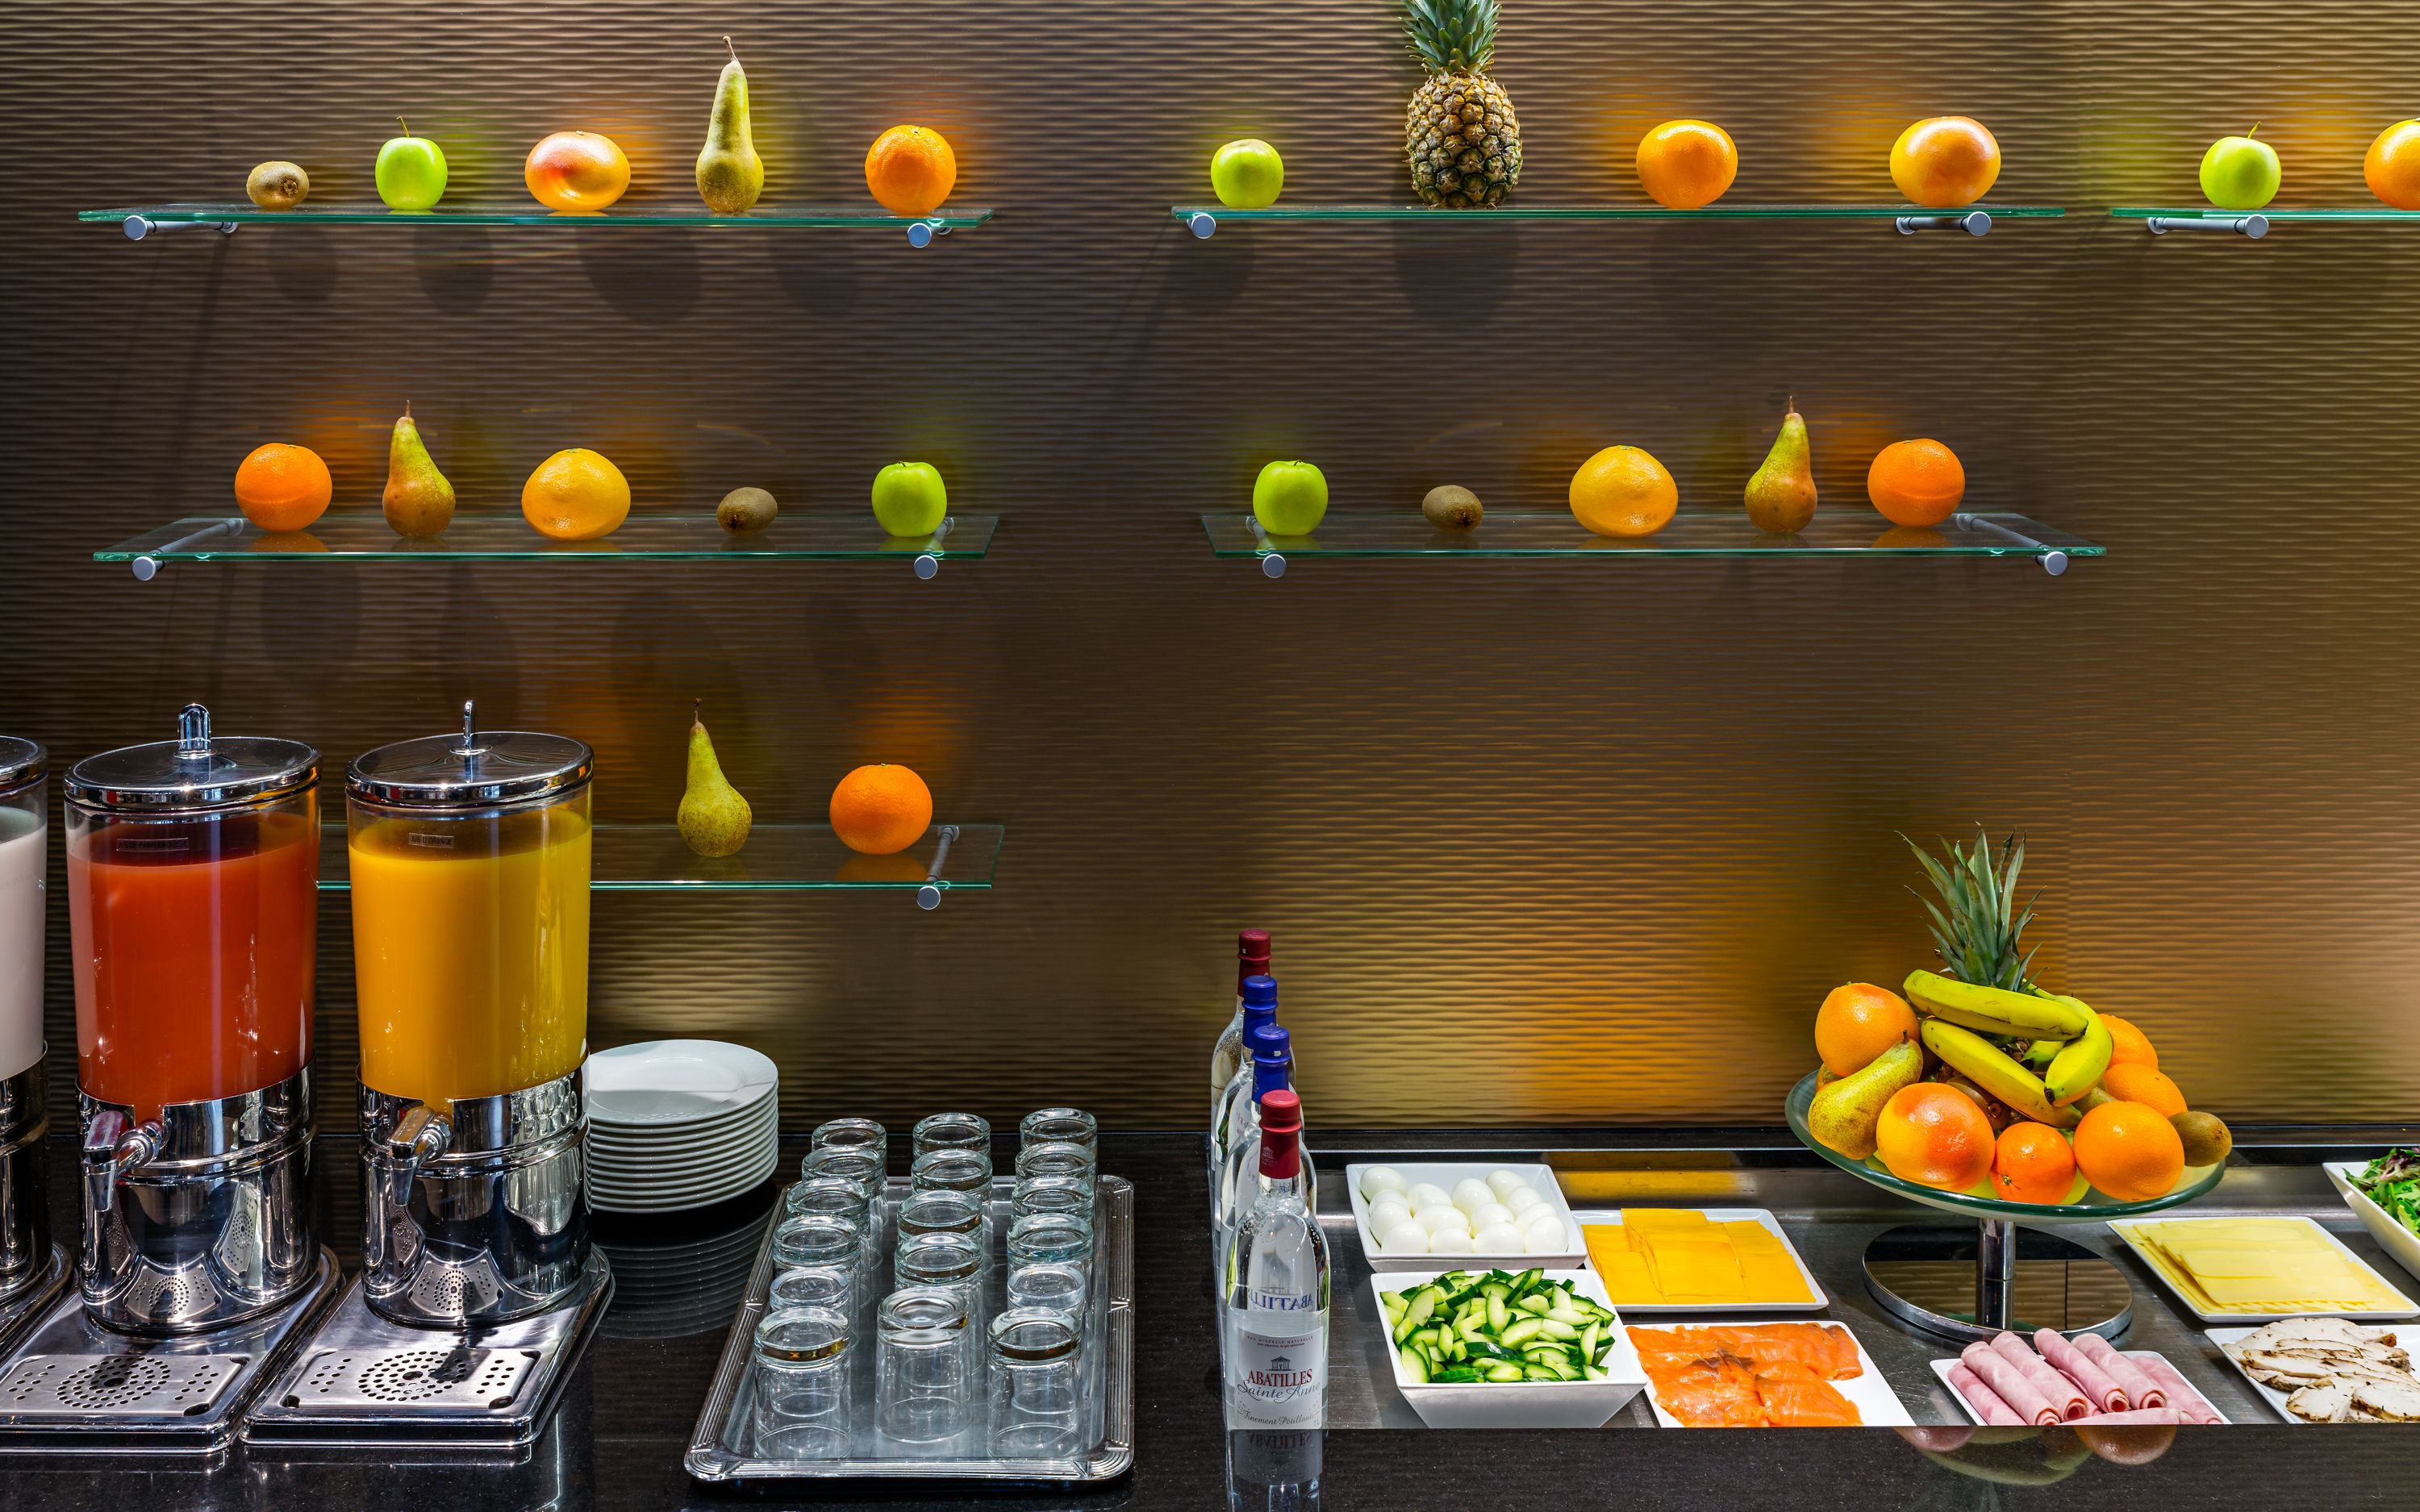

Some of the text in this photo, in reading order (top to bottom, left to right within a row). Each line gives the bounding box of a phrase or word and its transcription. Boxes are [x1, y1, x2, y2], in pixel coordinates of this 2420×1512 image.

[428, 837, 453, 845] ORANGE
[1248, 1369, 1312, 1387] ABATILLES
[1237, 1380, 1321, 1404] Sainte Anne
